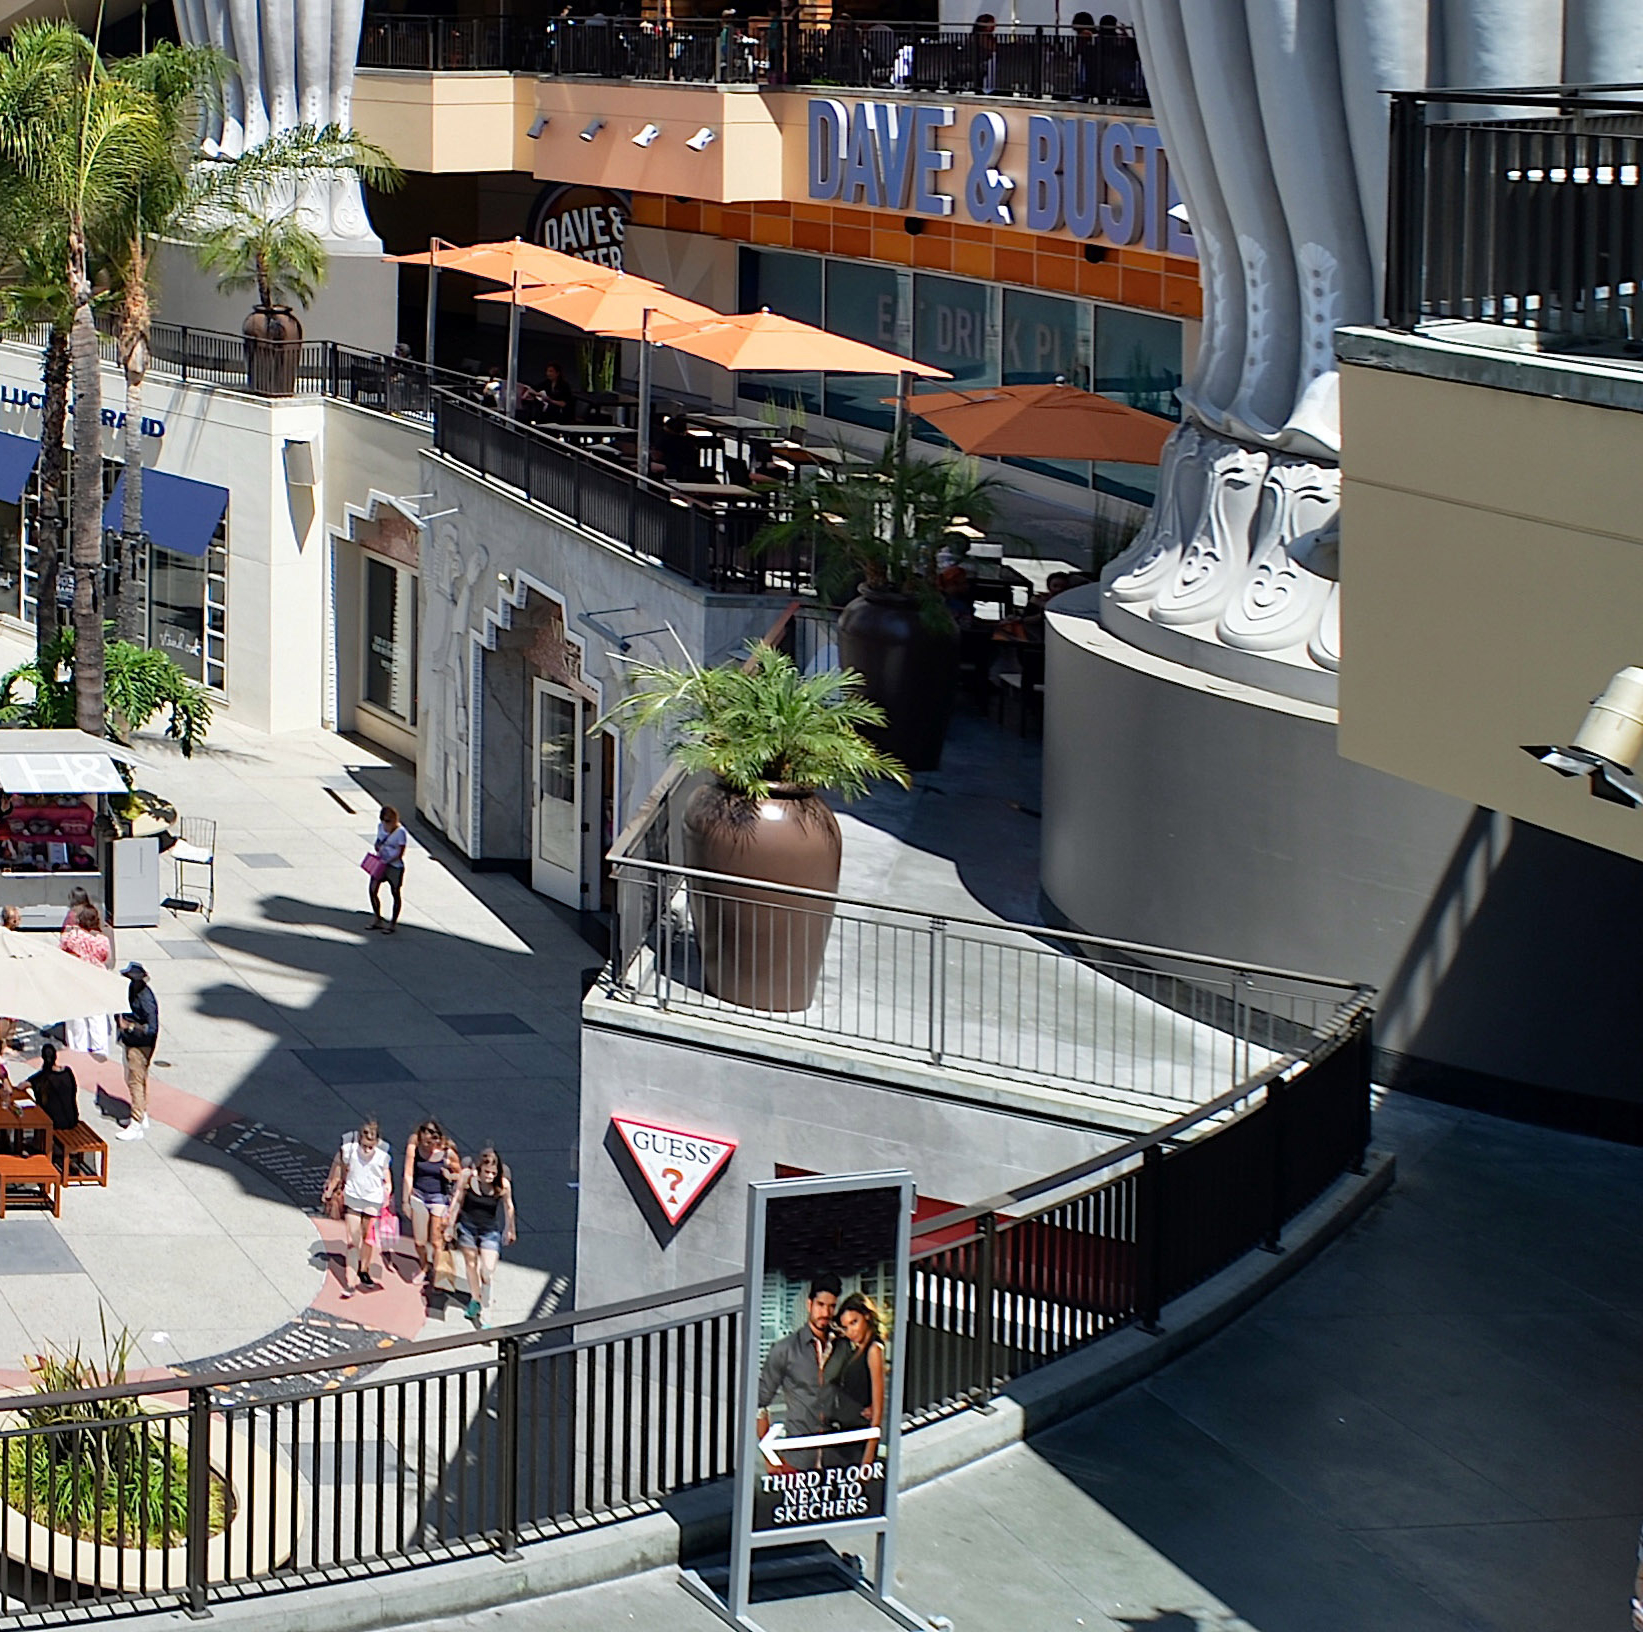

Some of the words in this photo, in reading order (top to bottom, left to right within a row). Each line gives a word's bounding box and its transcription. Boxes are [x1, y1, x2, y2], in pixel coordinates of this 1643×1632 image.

[808, 98, 956, 217] DAVE
[965, 110, 1016, 227] &
[545, 206, 610, 250] DAVE
[633, 1130, 711, 1165] GUESS
[761, 1471, 821, 1493] THIRD
[826, 1462, 885, 1486] FLOOR
[783, 1485, 833, 1506] NEXT
[838, 1481, 863, 1500] TO
[773, 1497, 869, 1524] SKECHERS
